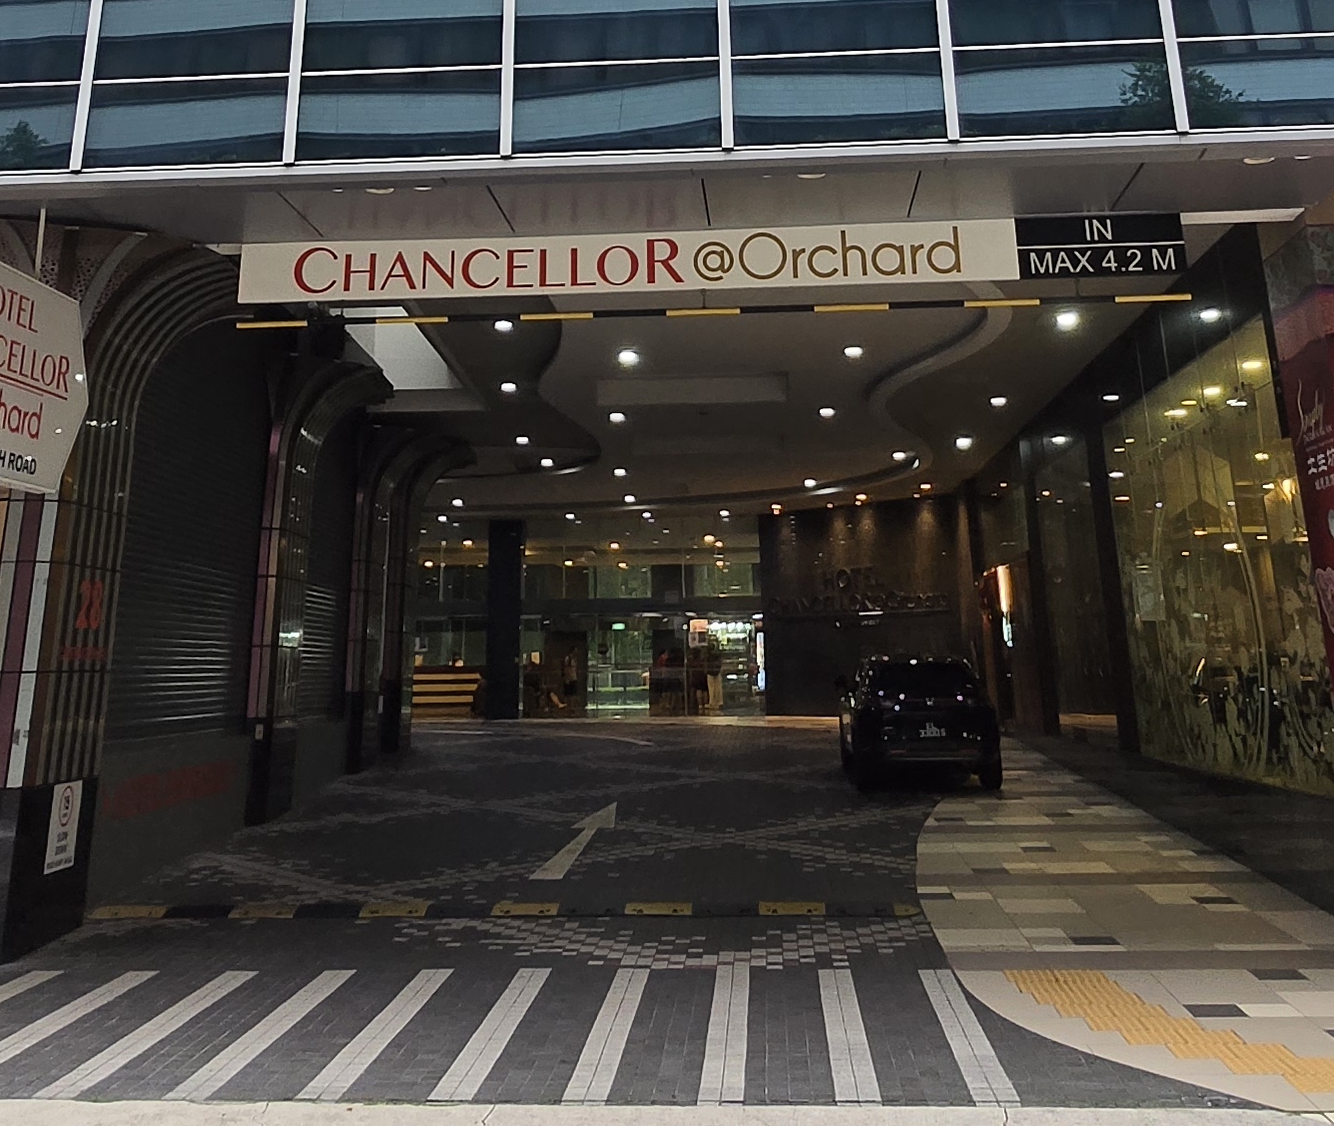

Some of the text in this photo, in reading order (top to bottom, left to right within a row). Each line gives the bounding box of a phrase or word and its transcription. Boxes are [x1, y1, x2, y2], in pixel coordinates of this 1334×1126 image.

[1084, 218, 1113, 241] IN
[293, 225, 964, 295] CHANCELLOR @Orchard
[1029, 247, 1177, 274] MAX 4.2 M
[8, 450, 38, 476] ROAD
